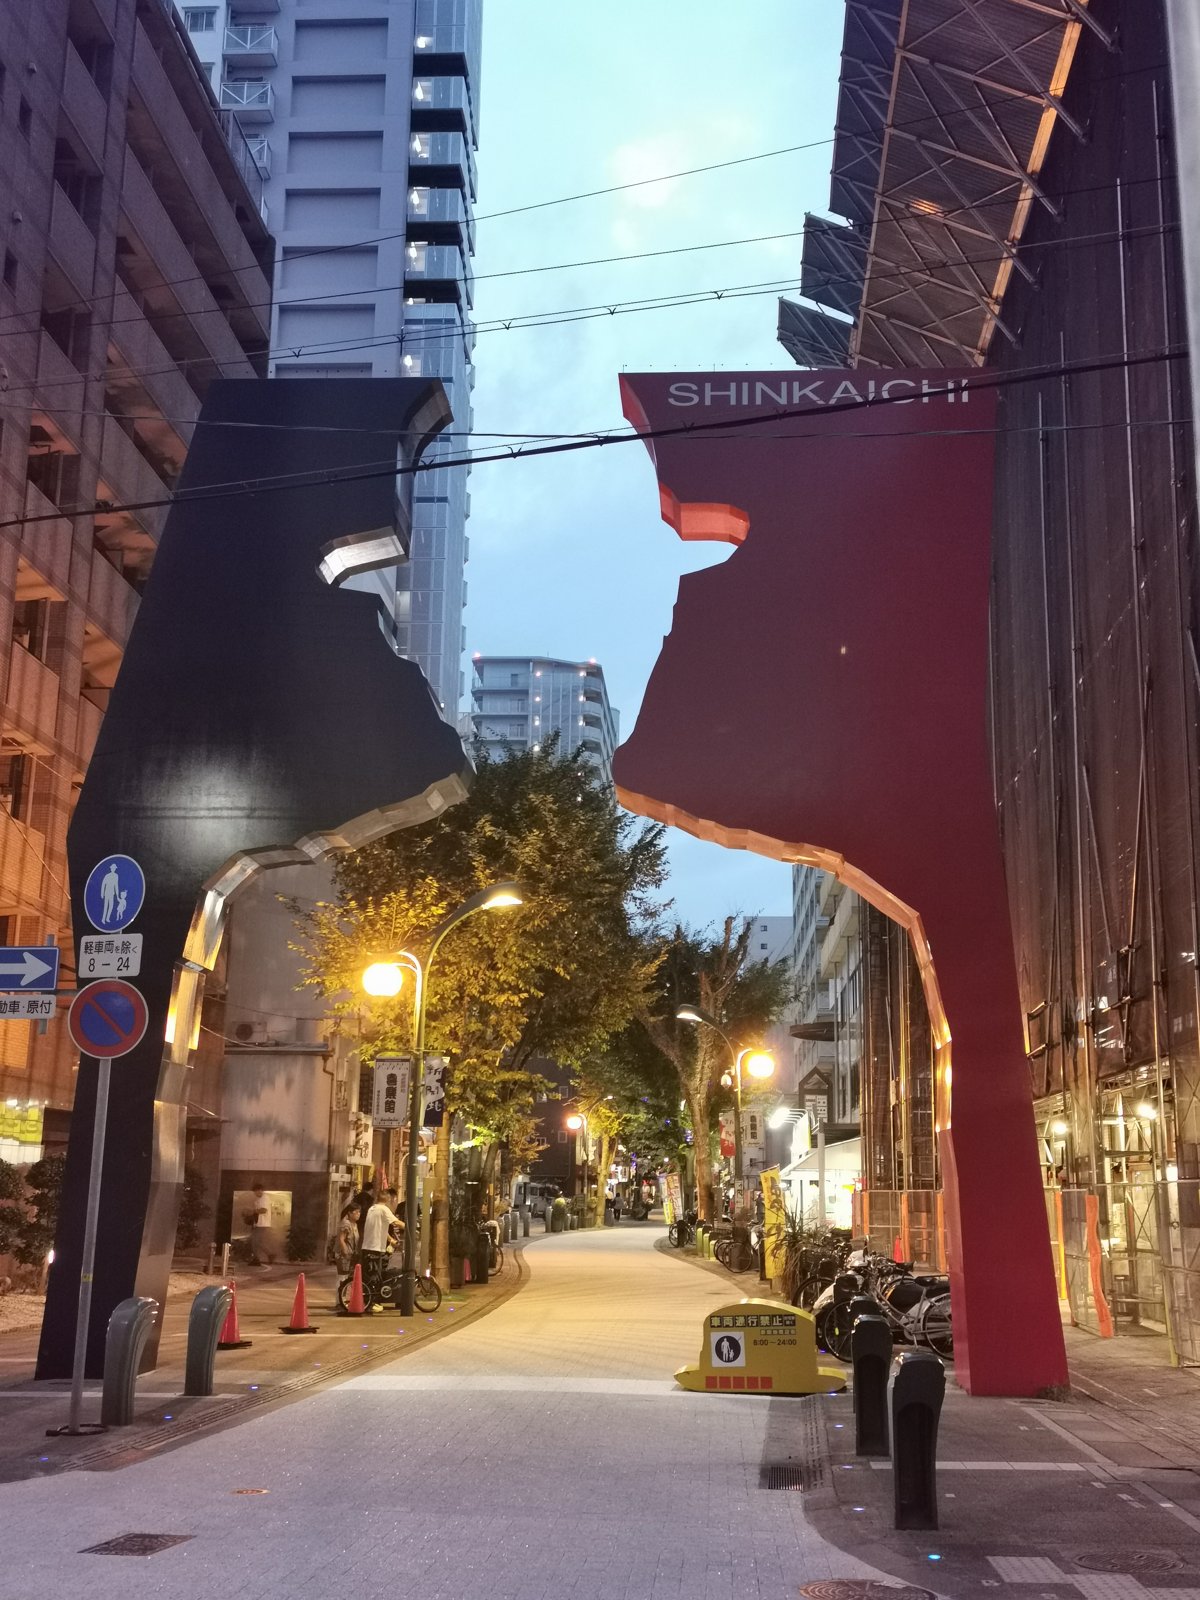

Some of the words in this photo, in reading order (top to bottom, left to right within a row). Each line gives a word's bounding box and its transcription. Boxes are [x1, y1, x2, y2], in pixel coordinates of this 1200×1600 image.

[667, 378, 969, 407] SHINKAICHI
[84, 940, 138, 955] 軽車両を除く
